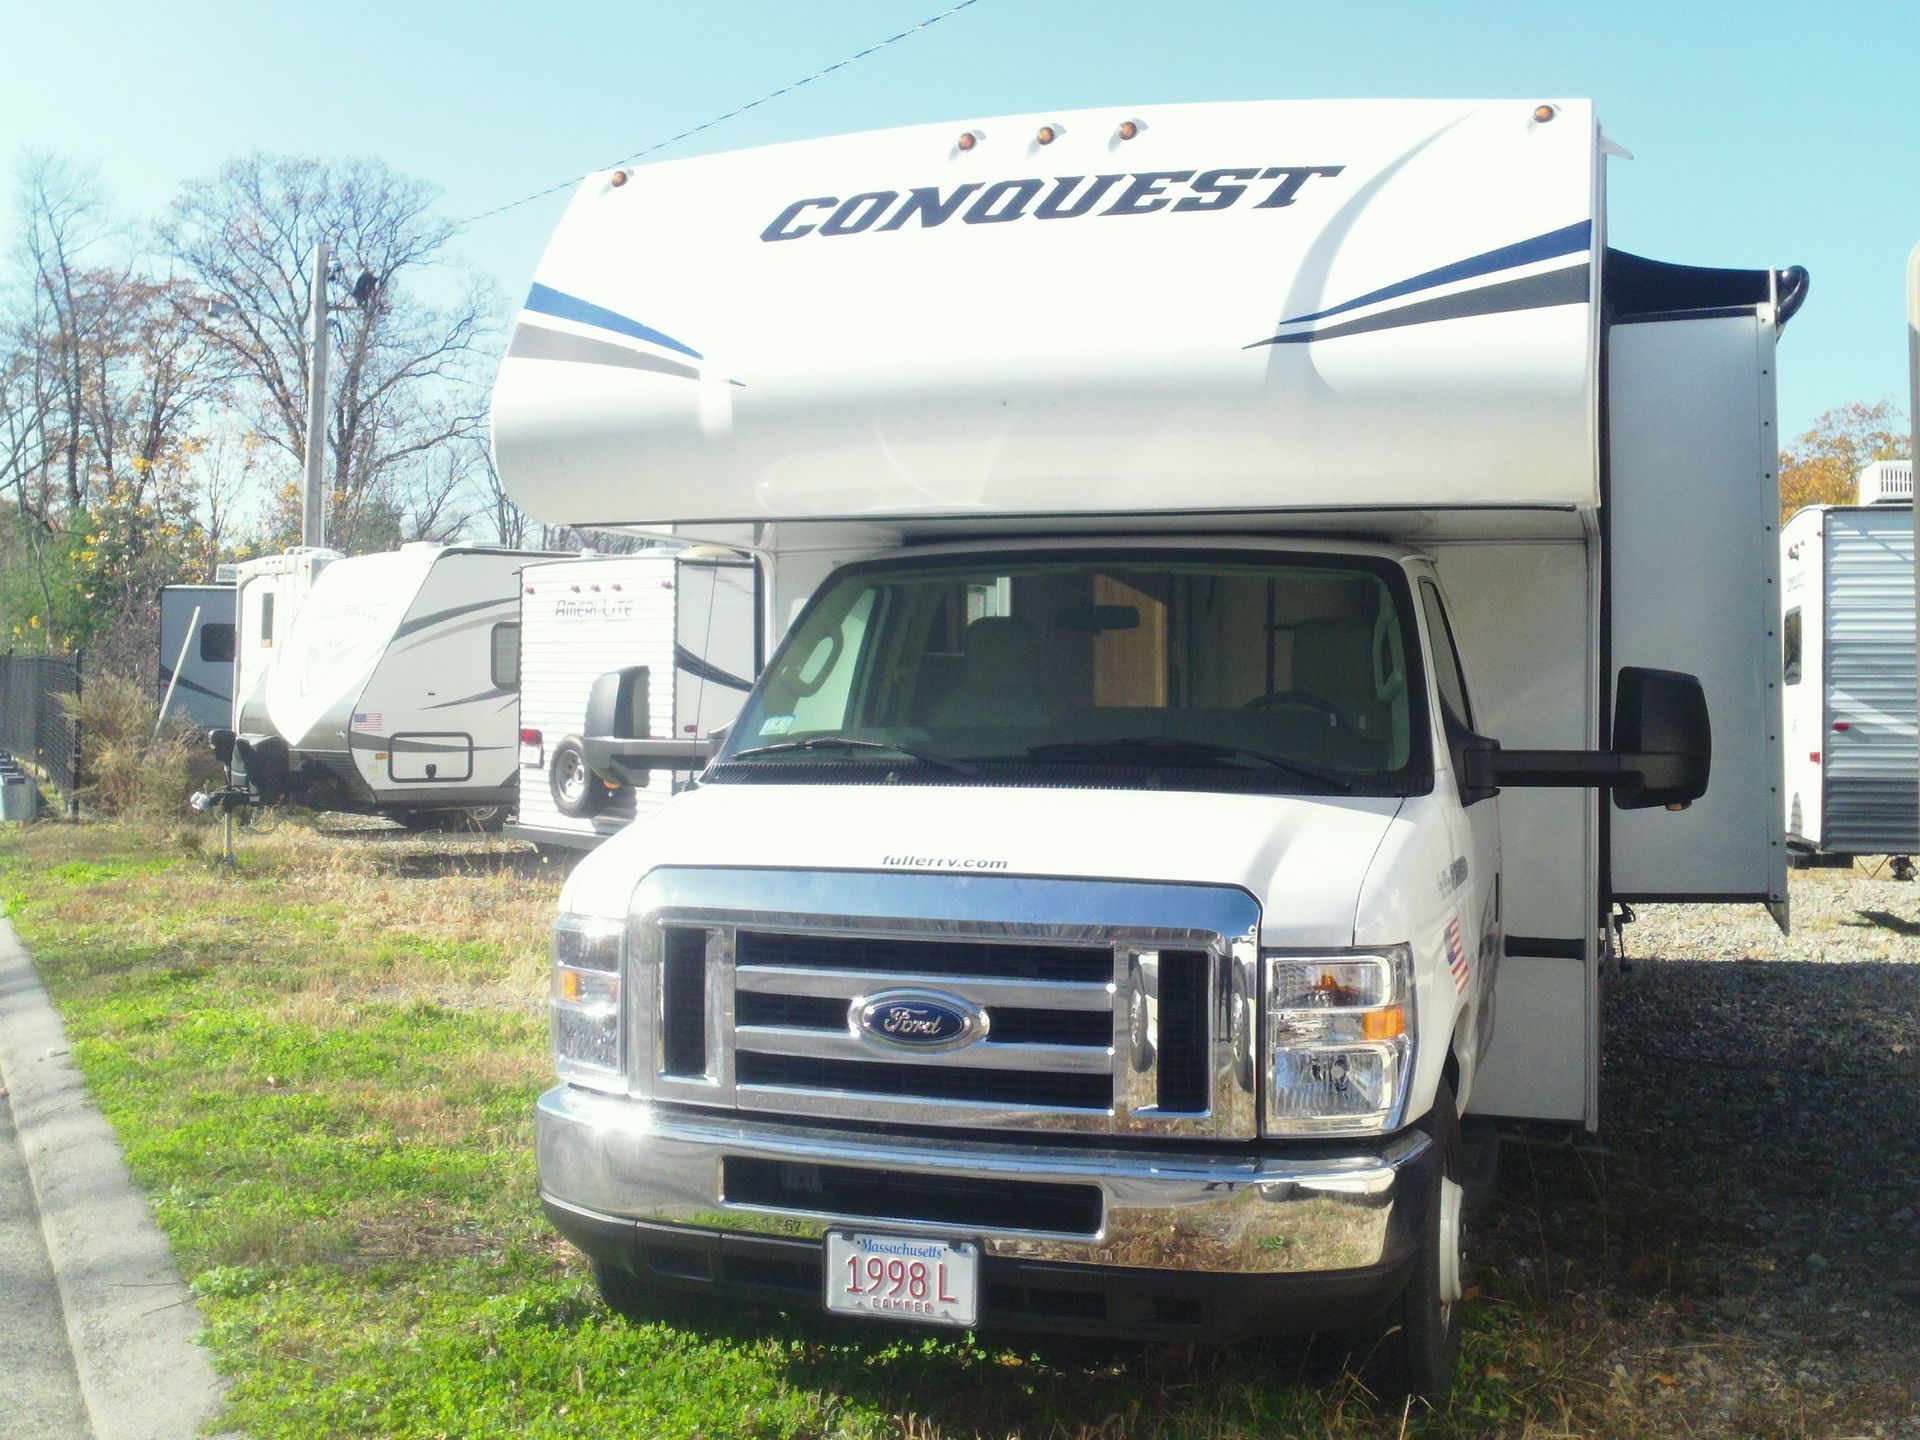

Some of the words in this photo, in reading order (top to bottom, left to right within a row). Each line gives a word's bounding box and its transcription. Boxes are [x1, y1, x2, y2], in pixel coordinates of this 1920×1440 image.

[759, 165, 1346, 242] CONQUEST
[882, 855, 1008, 869] fullerrv.com
[883, 1007, 942, 1034] Ford
[861, 1238, 943, 1259] Massachusetts
[845, 1255, 926, 1300] 1998
[937, 1263, 959, 1304] L
[870, 1296, 934, 1314] CAMPER
